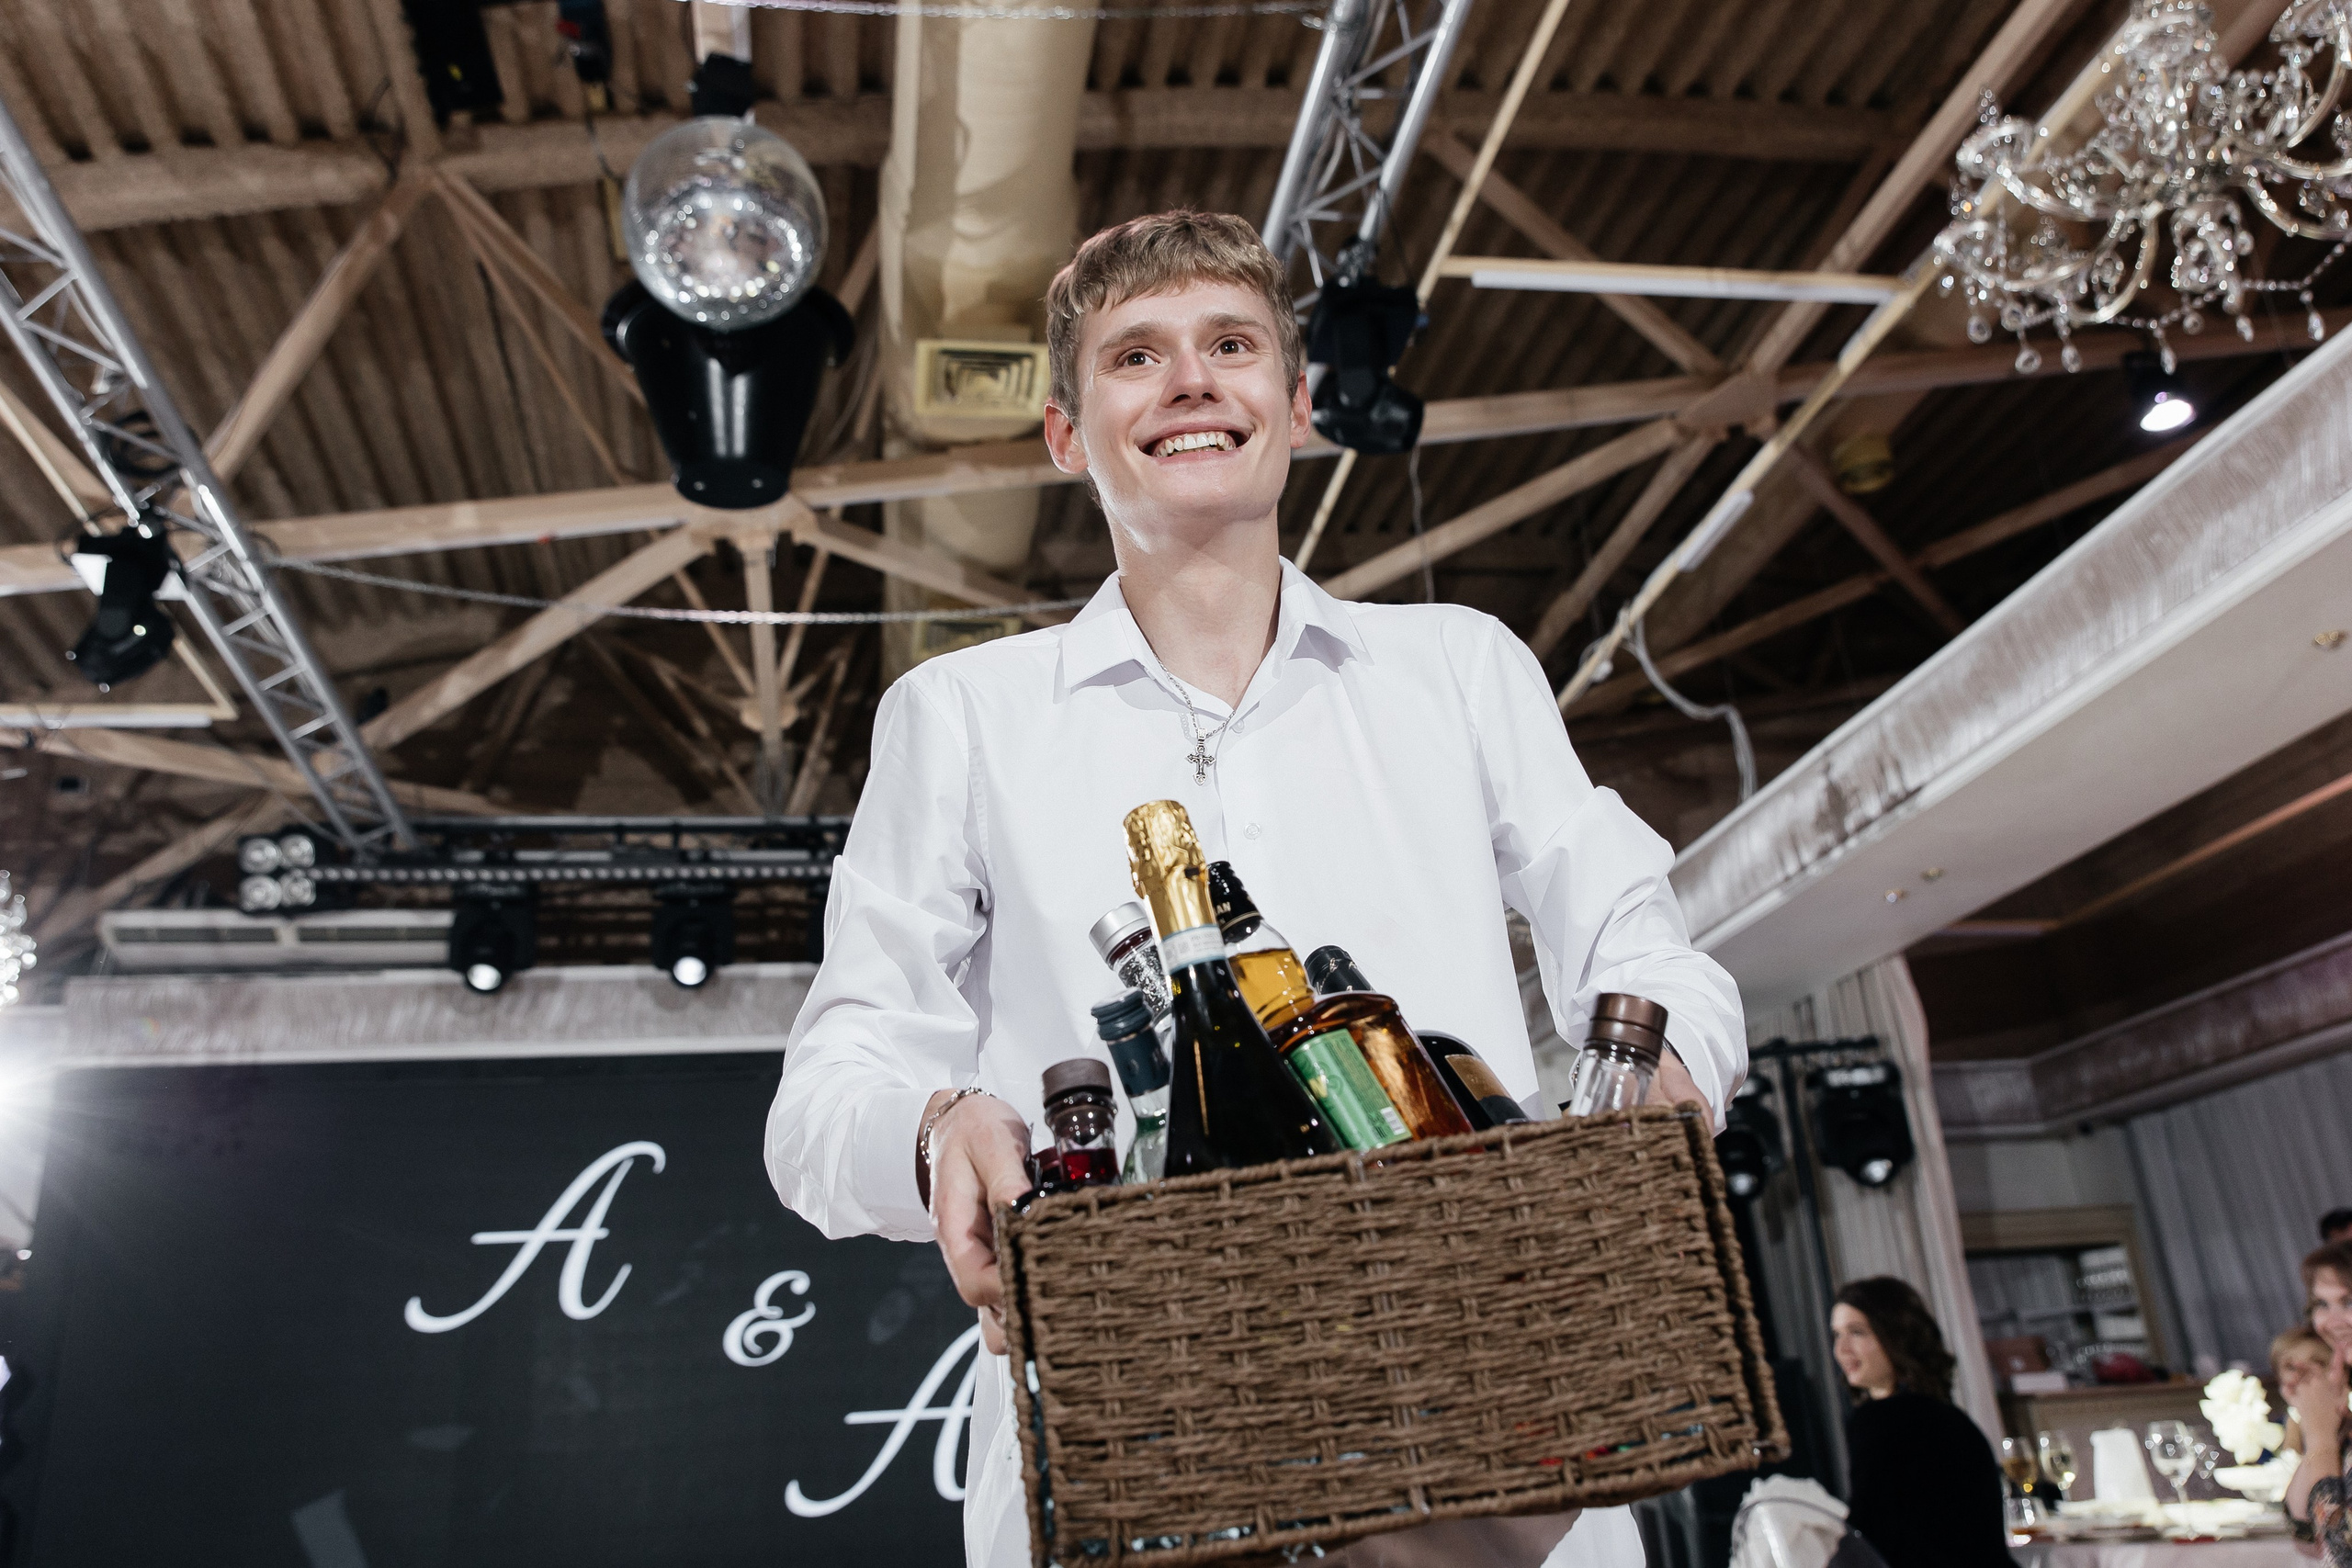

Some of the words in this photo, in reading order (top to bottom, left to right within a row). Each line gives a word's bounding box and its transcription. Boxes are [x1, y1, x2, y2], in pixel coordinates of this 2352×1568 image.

[1214, 901, 1231, 915] AN
[404, 1141, 666, 1333] A
[723, 1270, 816, 1366] &
